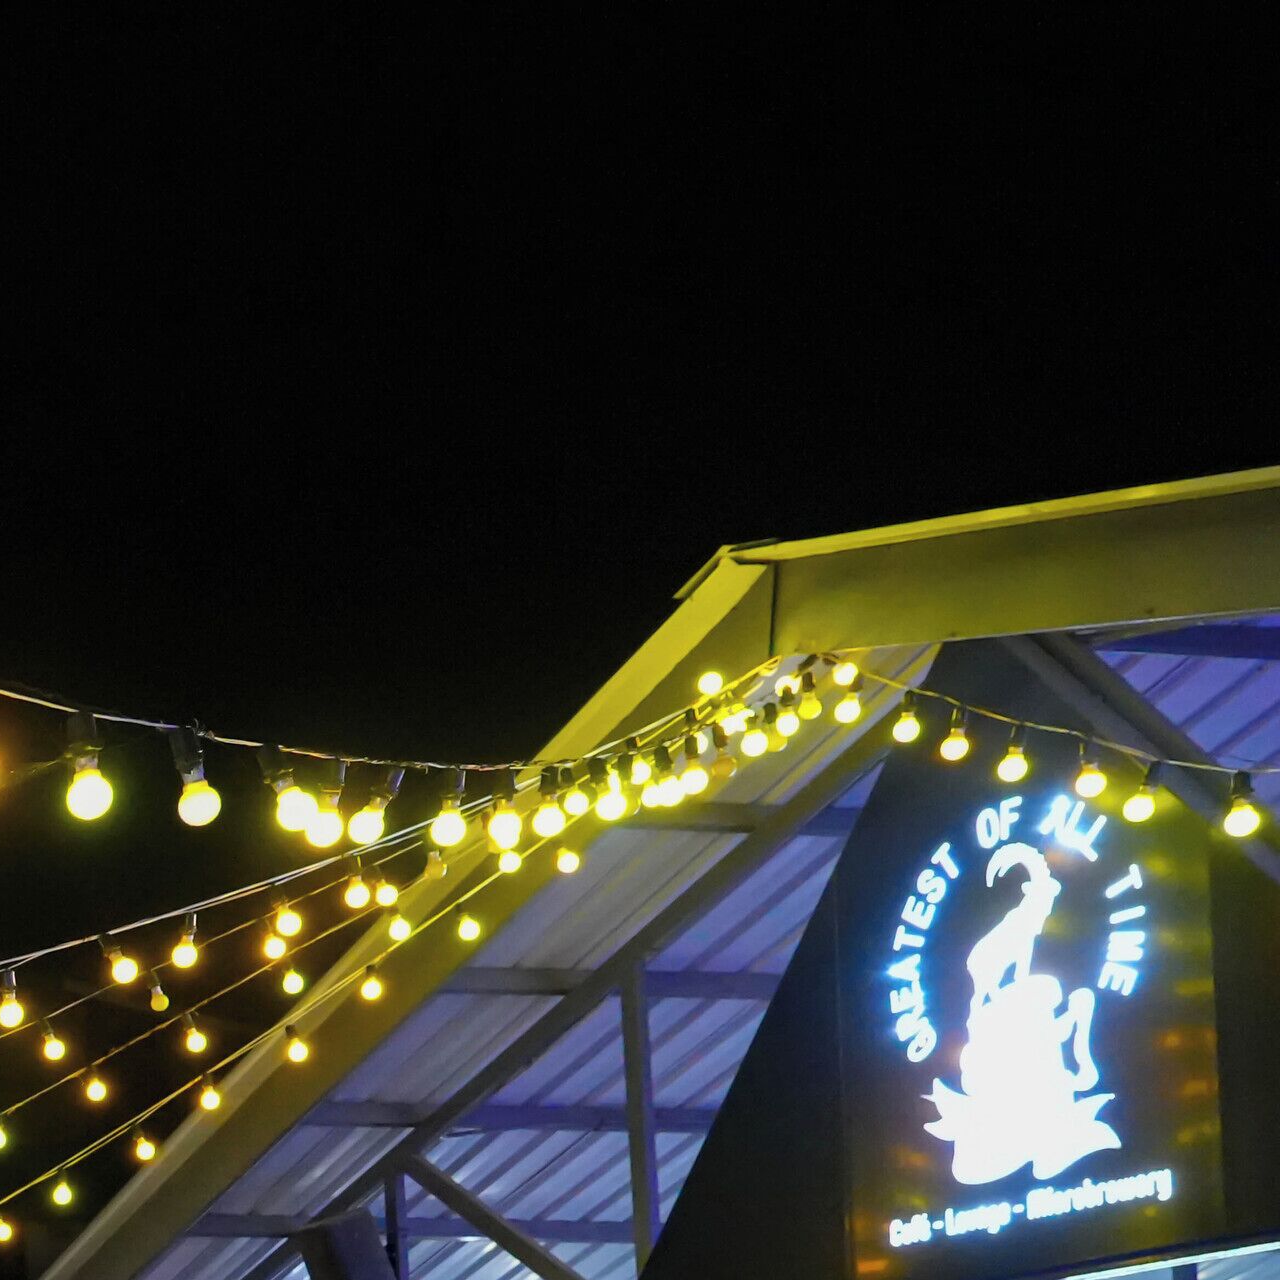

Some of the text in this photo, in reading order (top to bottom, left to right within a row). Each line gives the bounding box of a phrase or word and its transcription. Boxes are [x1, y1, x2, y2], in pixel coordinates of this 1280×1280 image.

[887, 795, 1146, 1063] GREATEST OF ALL TIME
